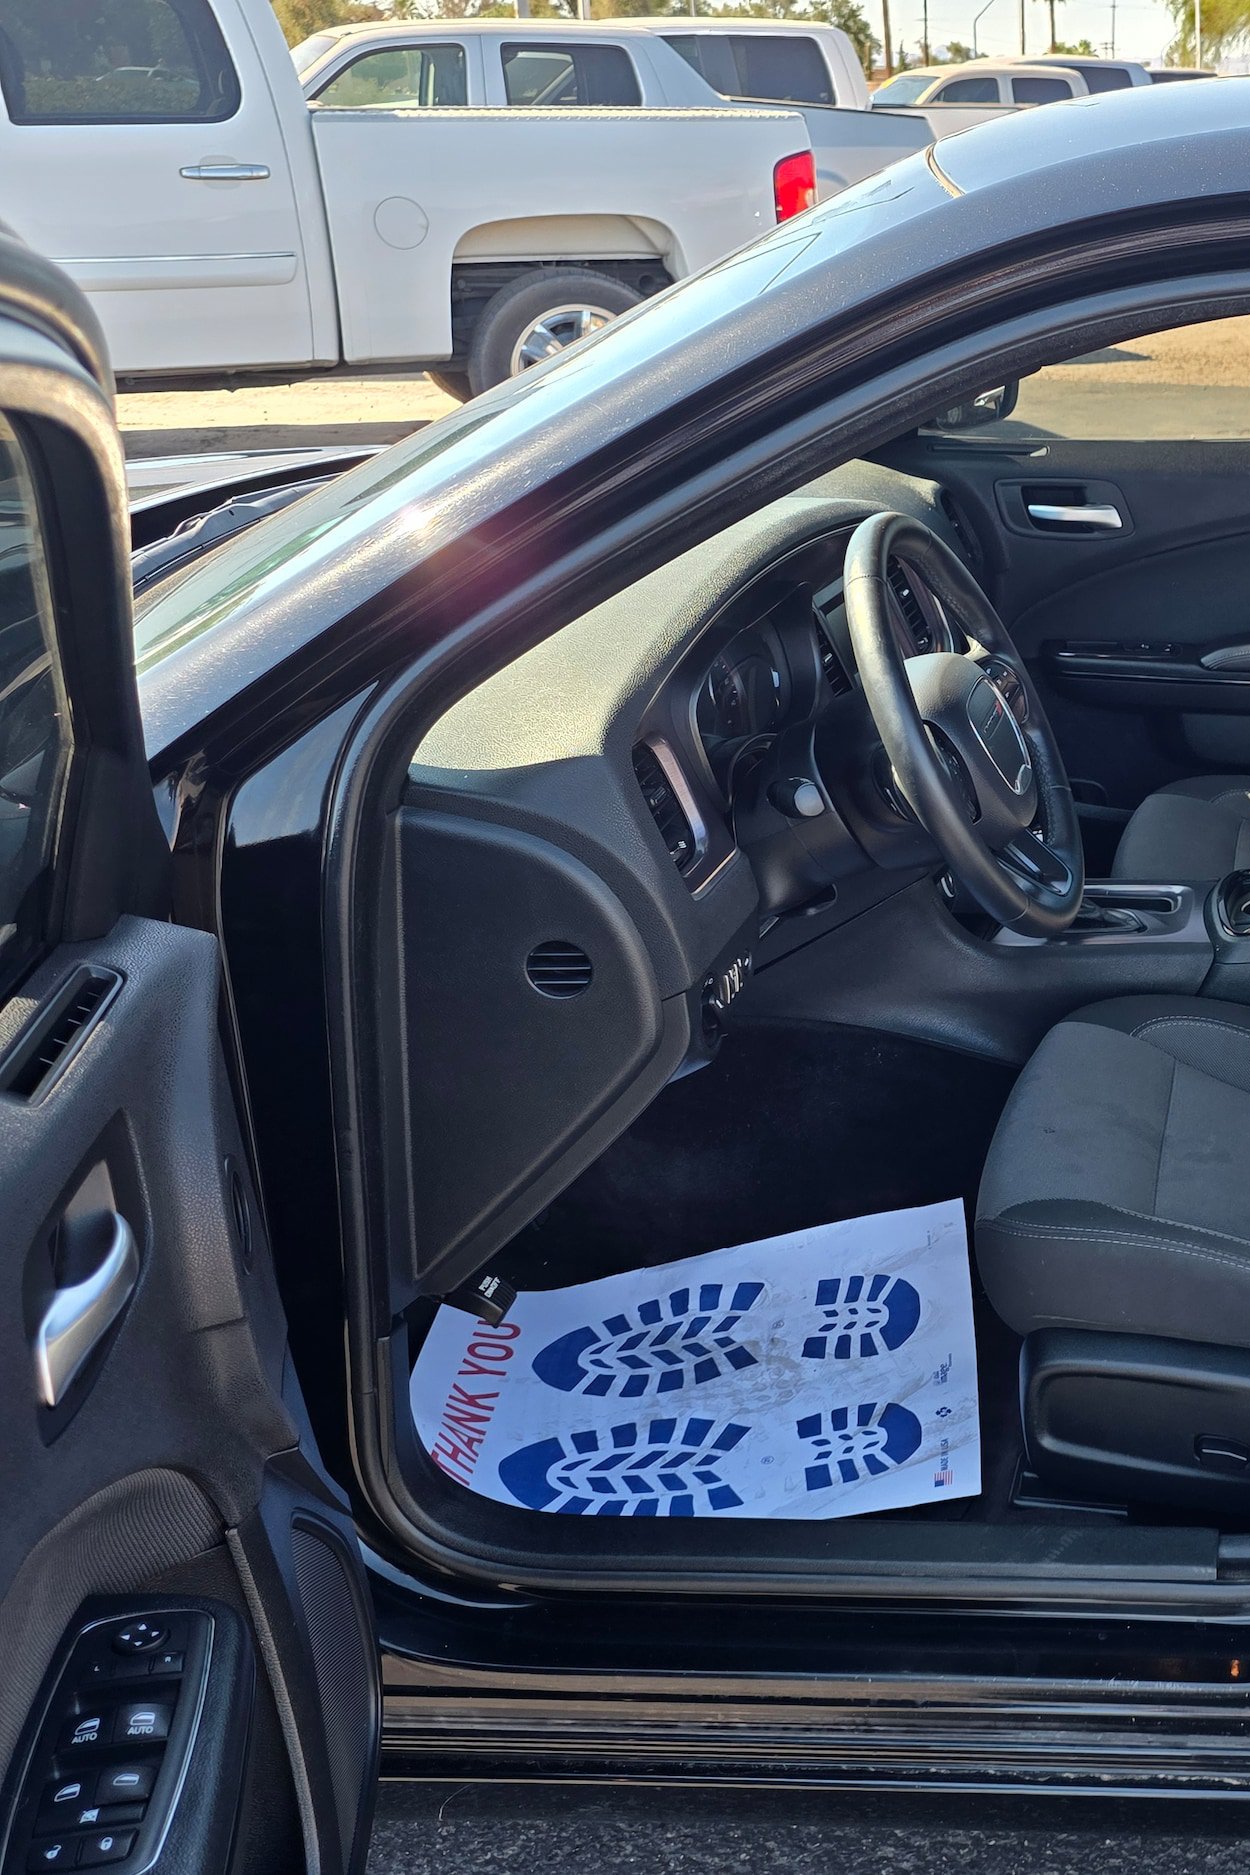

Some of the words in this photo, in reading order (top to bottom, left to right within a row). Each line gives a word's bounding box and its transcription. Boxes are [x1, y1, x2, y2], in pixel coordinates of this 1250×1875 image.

[458, 1320, 521, 1376] YOU
[431, 1383, 500, 1486] THANK
[71, 1732, 98, 1744] AUTO
[127, 1725, 154, 1735] AUTO
